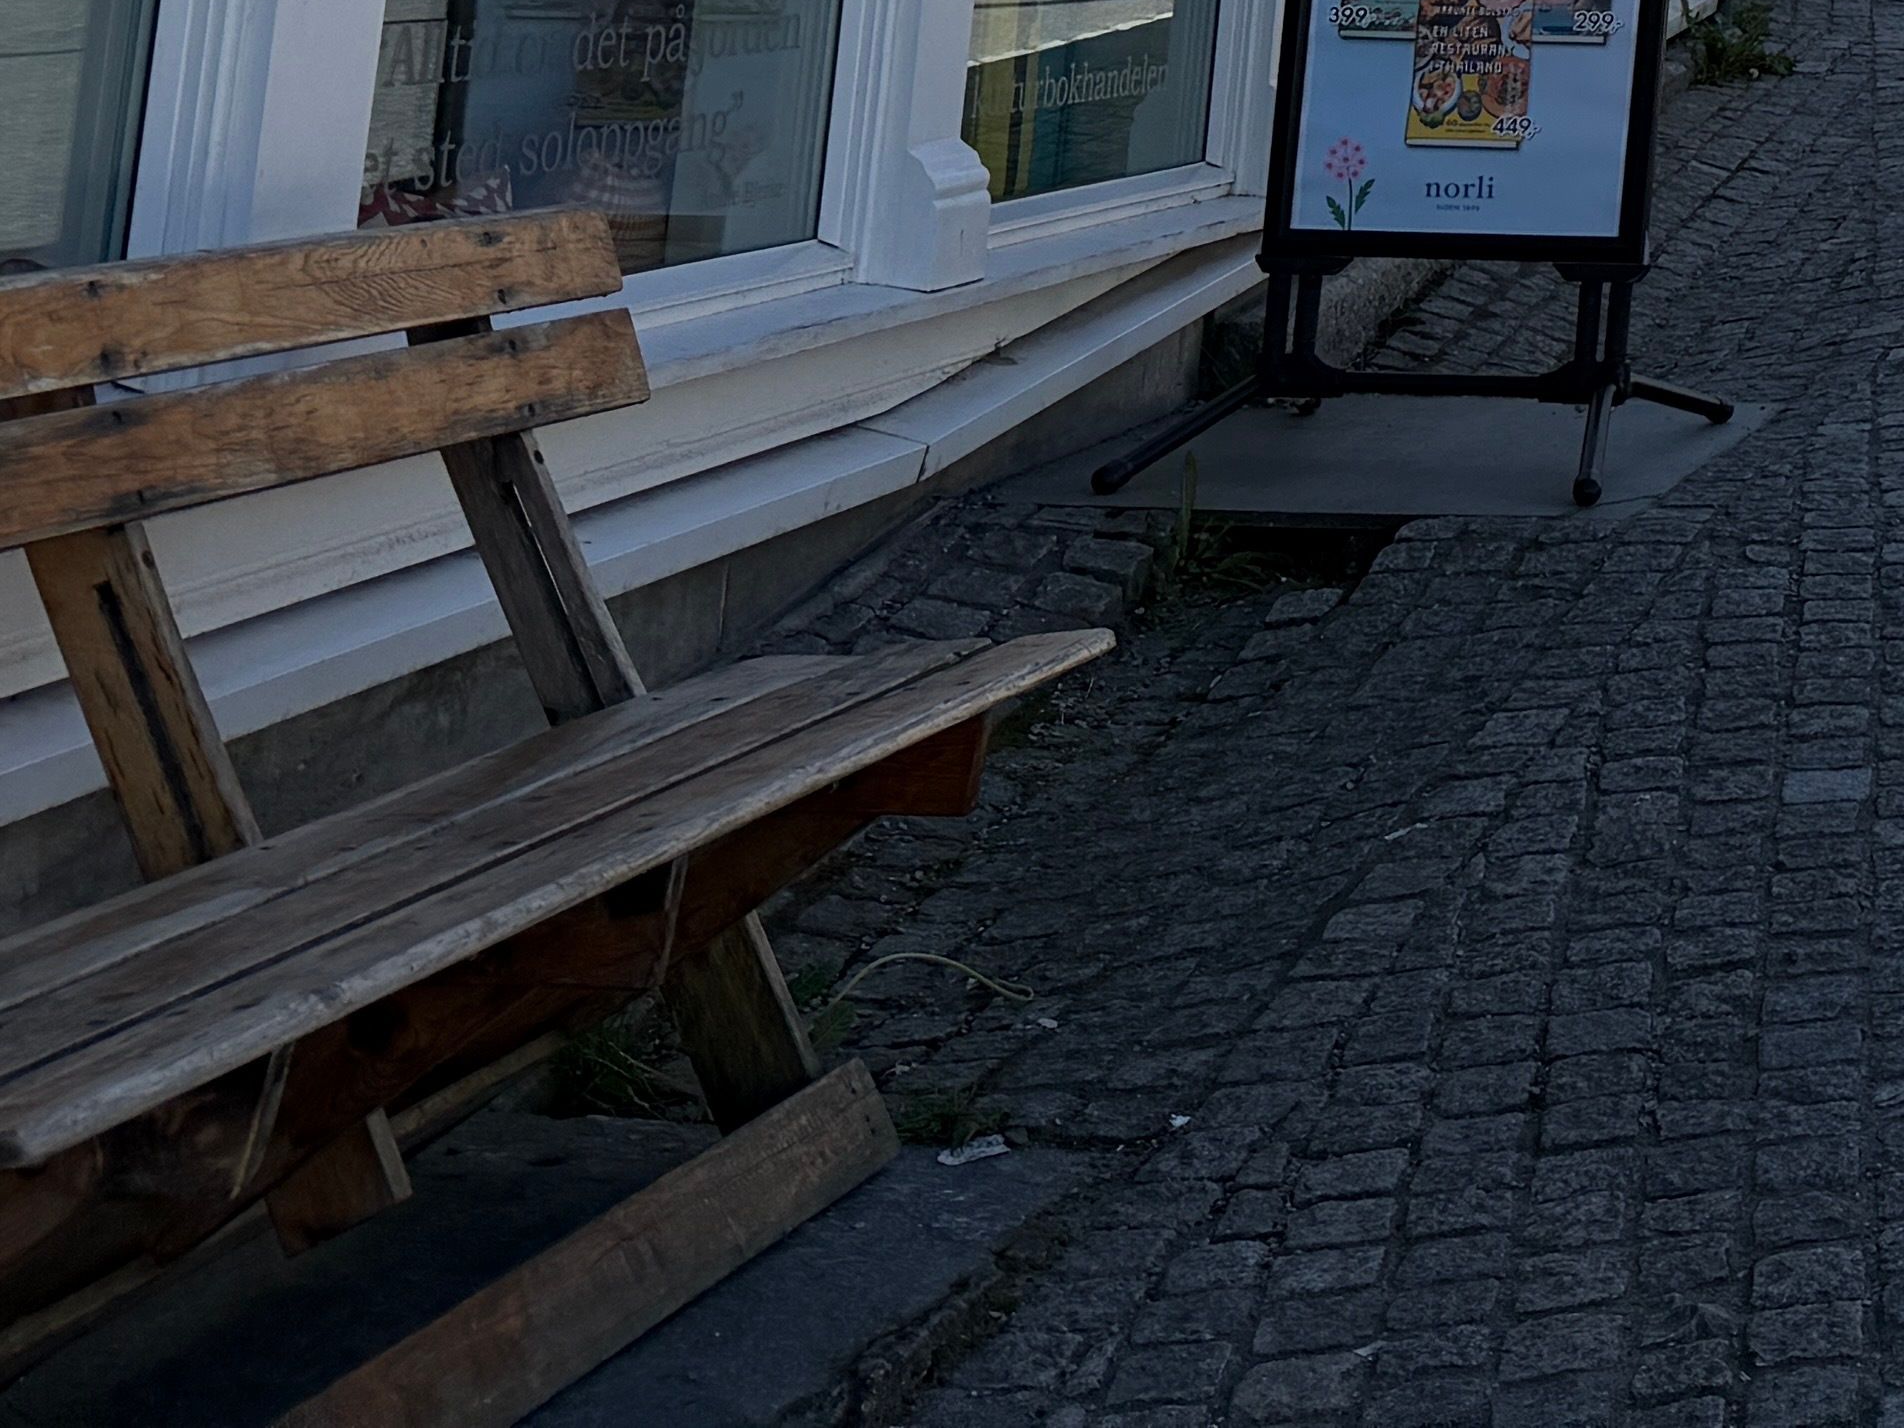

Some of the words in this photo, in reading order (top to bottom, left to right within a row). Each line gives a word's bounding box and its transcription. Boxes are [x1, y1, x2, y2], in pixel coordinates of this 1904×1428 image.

[1452, 24, 1489, 38] LITEN
[1574, 10, 1625, 35] 299,-
[571, 10, 632, 72] det
[639, 2, 688, 83] på
[1492, 117, 1541, 139] 449,-
[1425, 175, 1495, 199] norli
